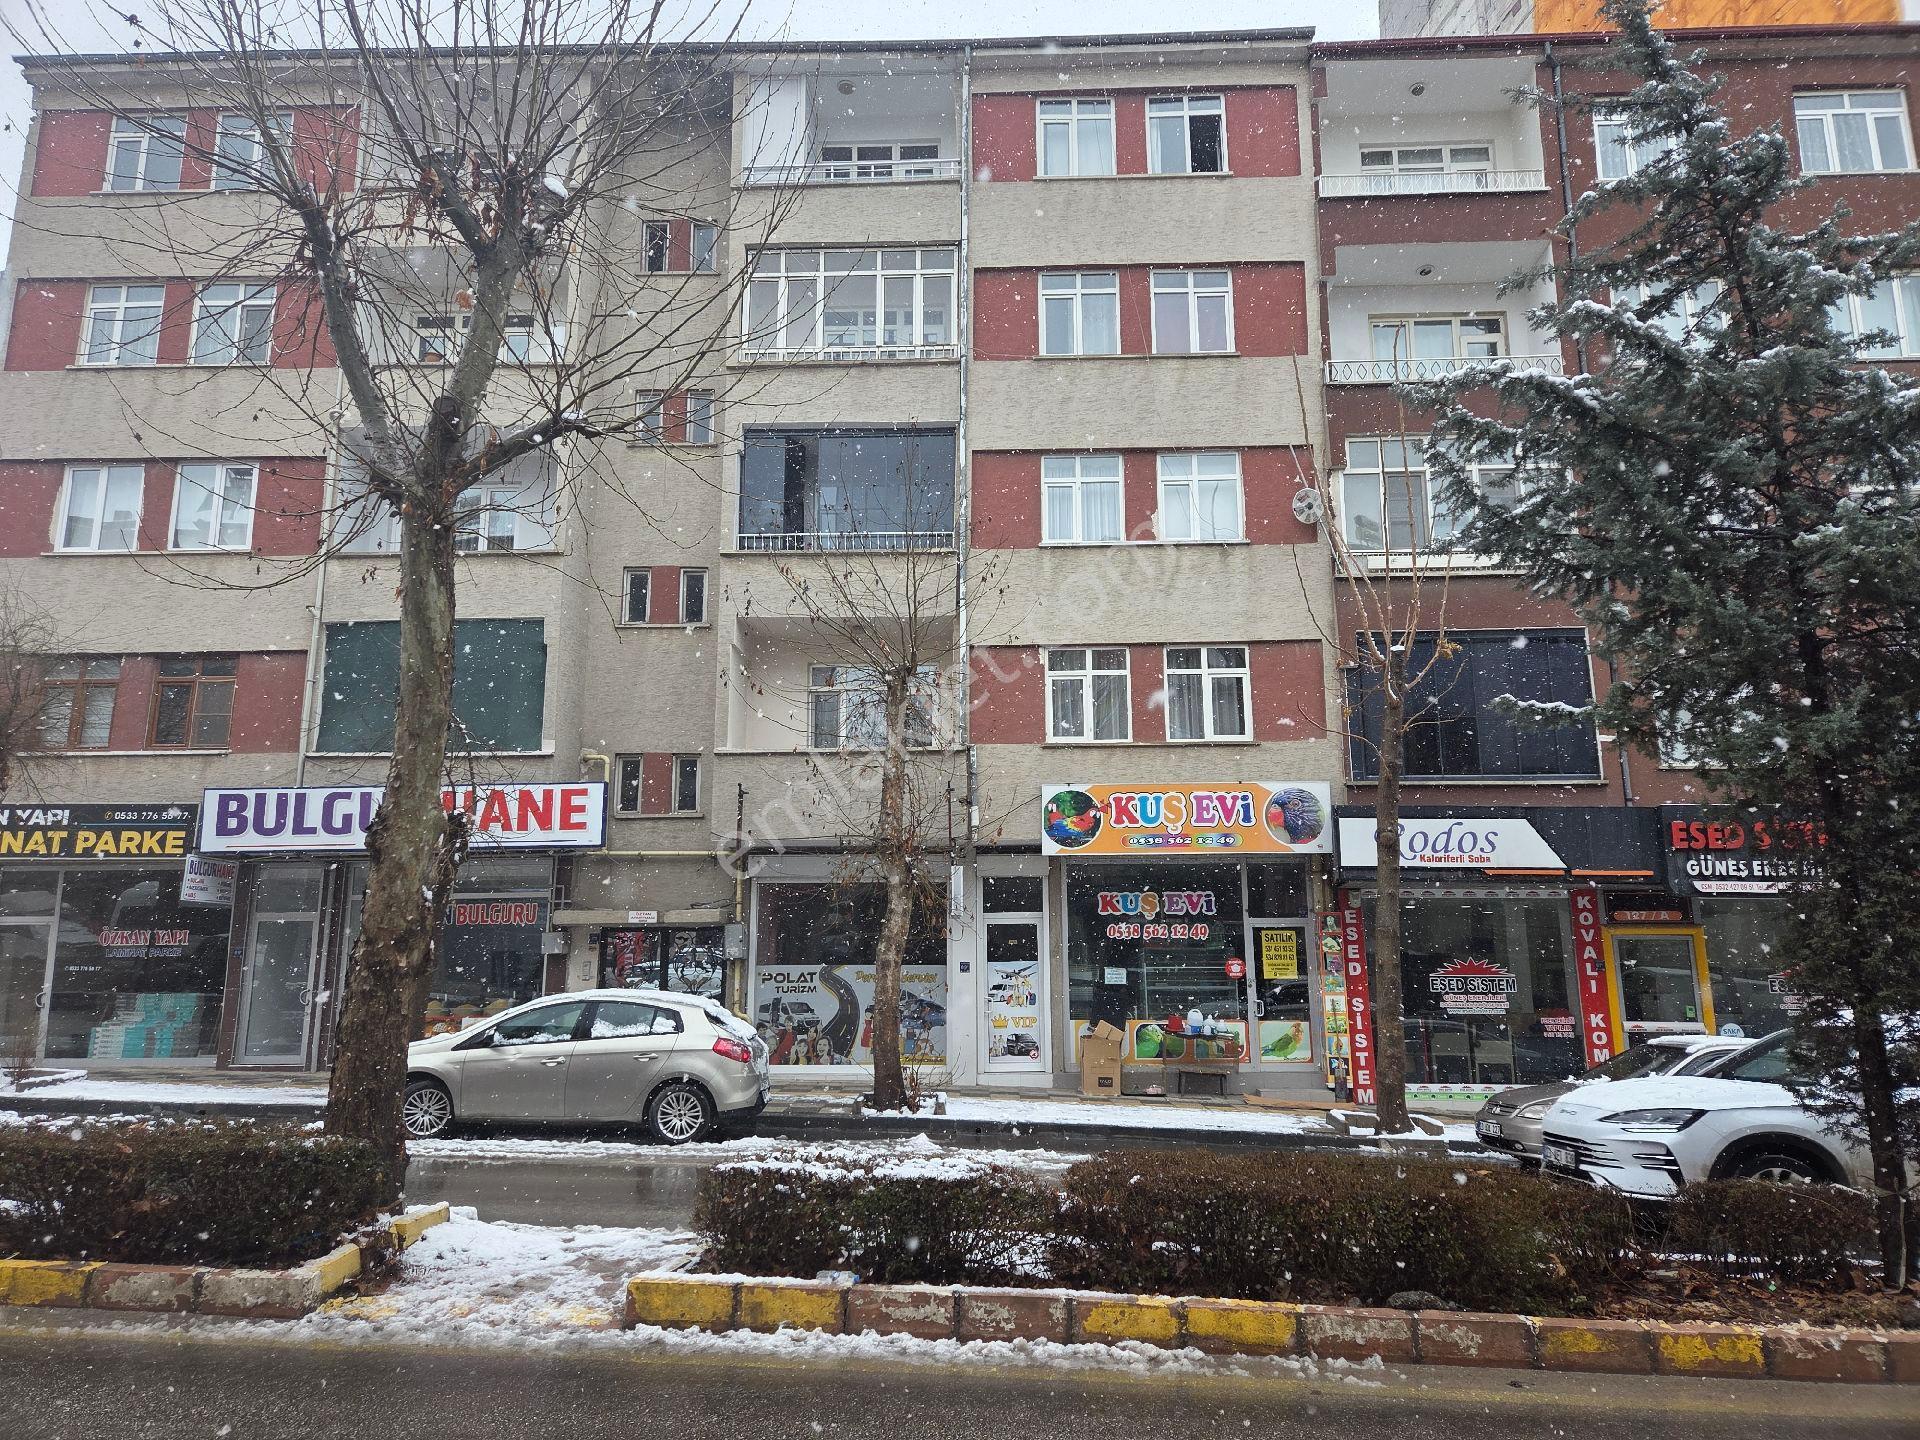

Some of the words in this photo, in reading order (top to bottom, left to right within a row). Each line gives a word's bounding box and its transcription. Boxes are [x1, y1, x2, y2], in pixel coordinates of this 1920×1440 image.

[16, 809, 70, 826] YAPI
[114, 811, 138, 820] 0533
[141, 811, 158, 820] 776
[1110, 793, 1187, 833] KUŞ
[74, 830, 187, 854] PARKE
[1129, 837, 1163, 845] 0538
[1167, 837, 1192, 845] 562
[1196, 837, 1213, 845] 12
[1216, 837, 1235, 845] 49
[1671, 820, 1745, 849] ESED
[1419, 854, 1465, 863] Kaloriferli
[1686, 854, 1749, 878] GÜNEŞ
[455, 902, 539, 926] BULGURU
[1098, 892, 1158, 919] KUŞ
[100, 926, 150, 947] ÖZKAN
[154, 929, 190, 946] YAPI
[1106, 923, 1140, 939] 0538
[1143, 923, 1167, 939] 562
[1171, 923, 1188, 939] 12
[1190, 923, 1209, 939] 49
[1264, 933, 1294, 943] SATILIK
[1344, 909, 1362, 976] ESED
[1576, 895, 1599, 994] KOVALI
[761, 972, 818, 984] POLAT
[1430, 977, 1466, 993] ESED
[1011, 1016, 1038, 1028] VIP
